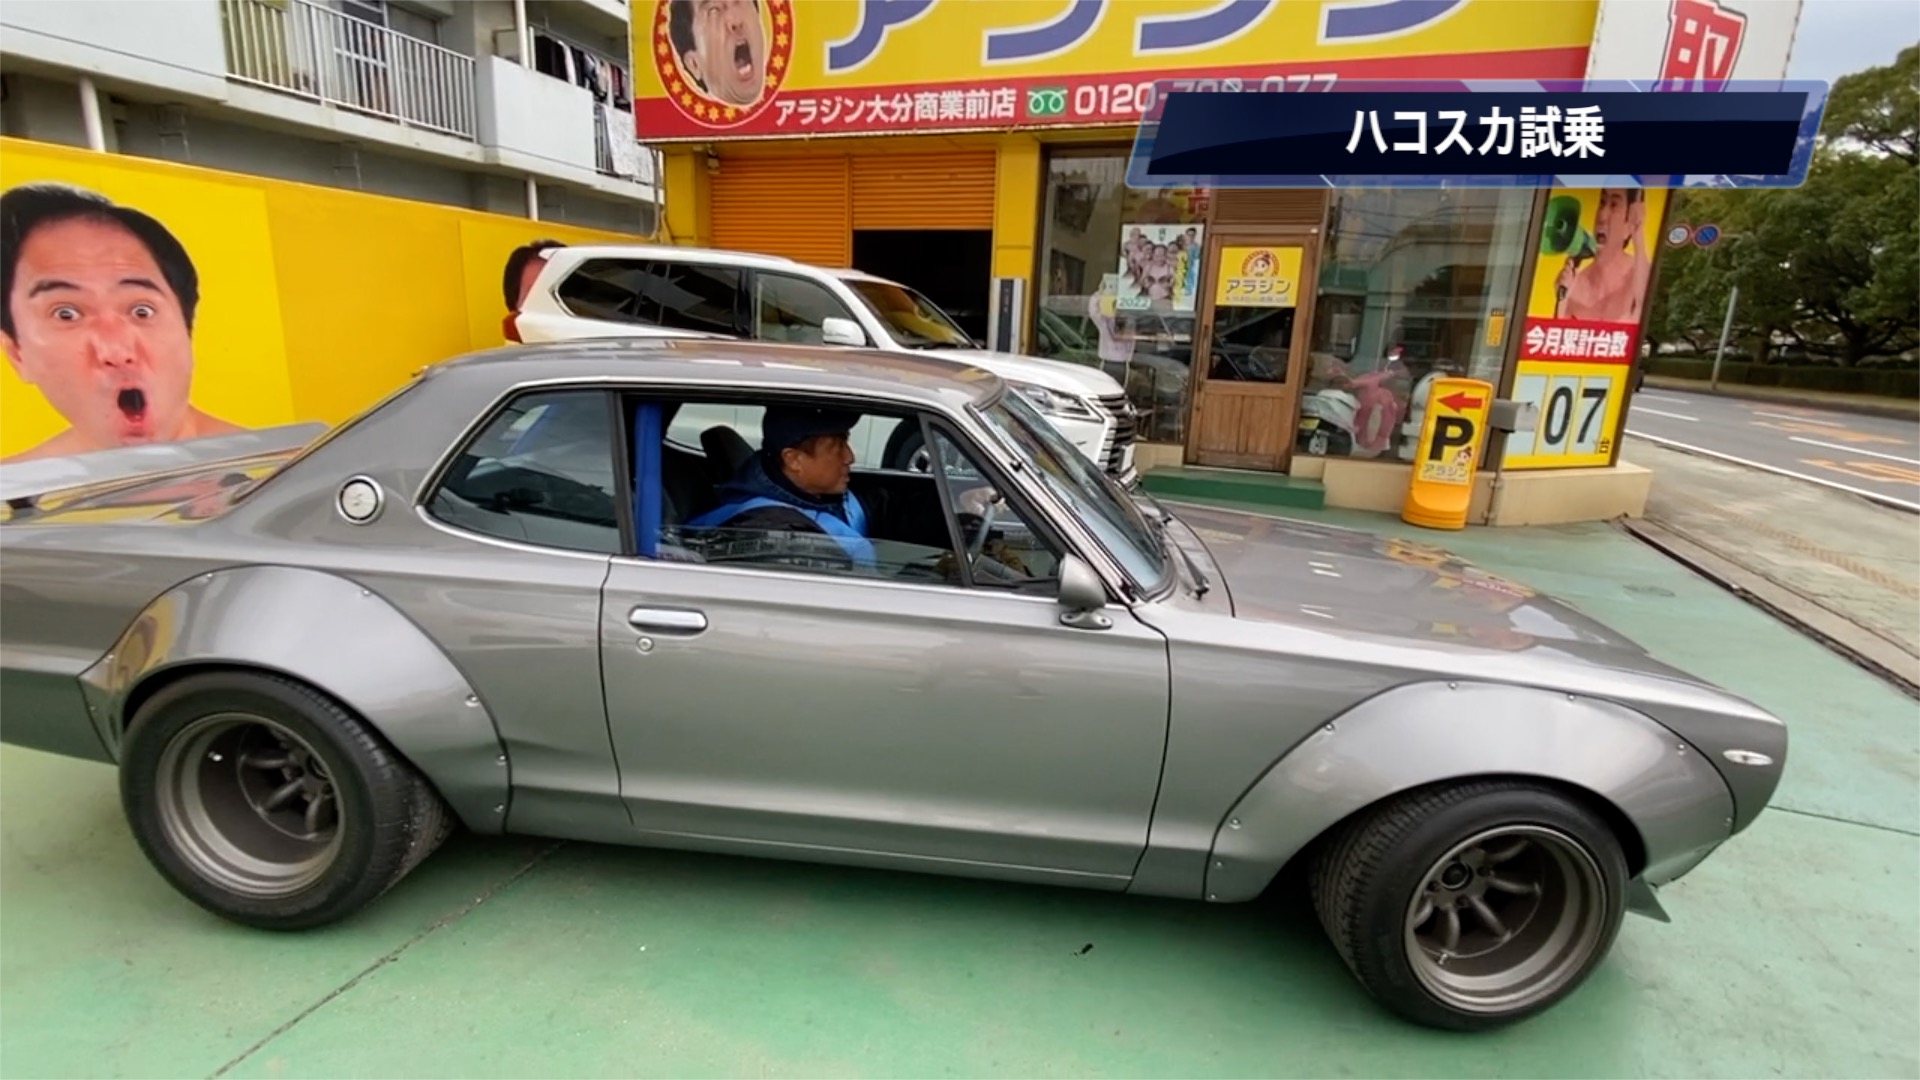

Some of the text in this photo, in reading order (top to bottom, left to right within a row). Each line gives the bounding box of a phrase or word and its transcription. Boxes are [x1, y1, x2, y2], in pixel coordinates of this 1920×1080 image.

[774, 88, 1018, 127] アラジン大分商業前店
[1225, 279, 1291, 295] アラジン
[1526, 325, 1629, 357] 今月累計台数
[1544, 386, 1608, 446] 07
[1429, 416, 1475, 461] P
